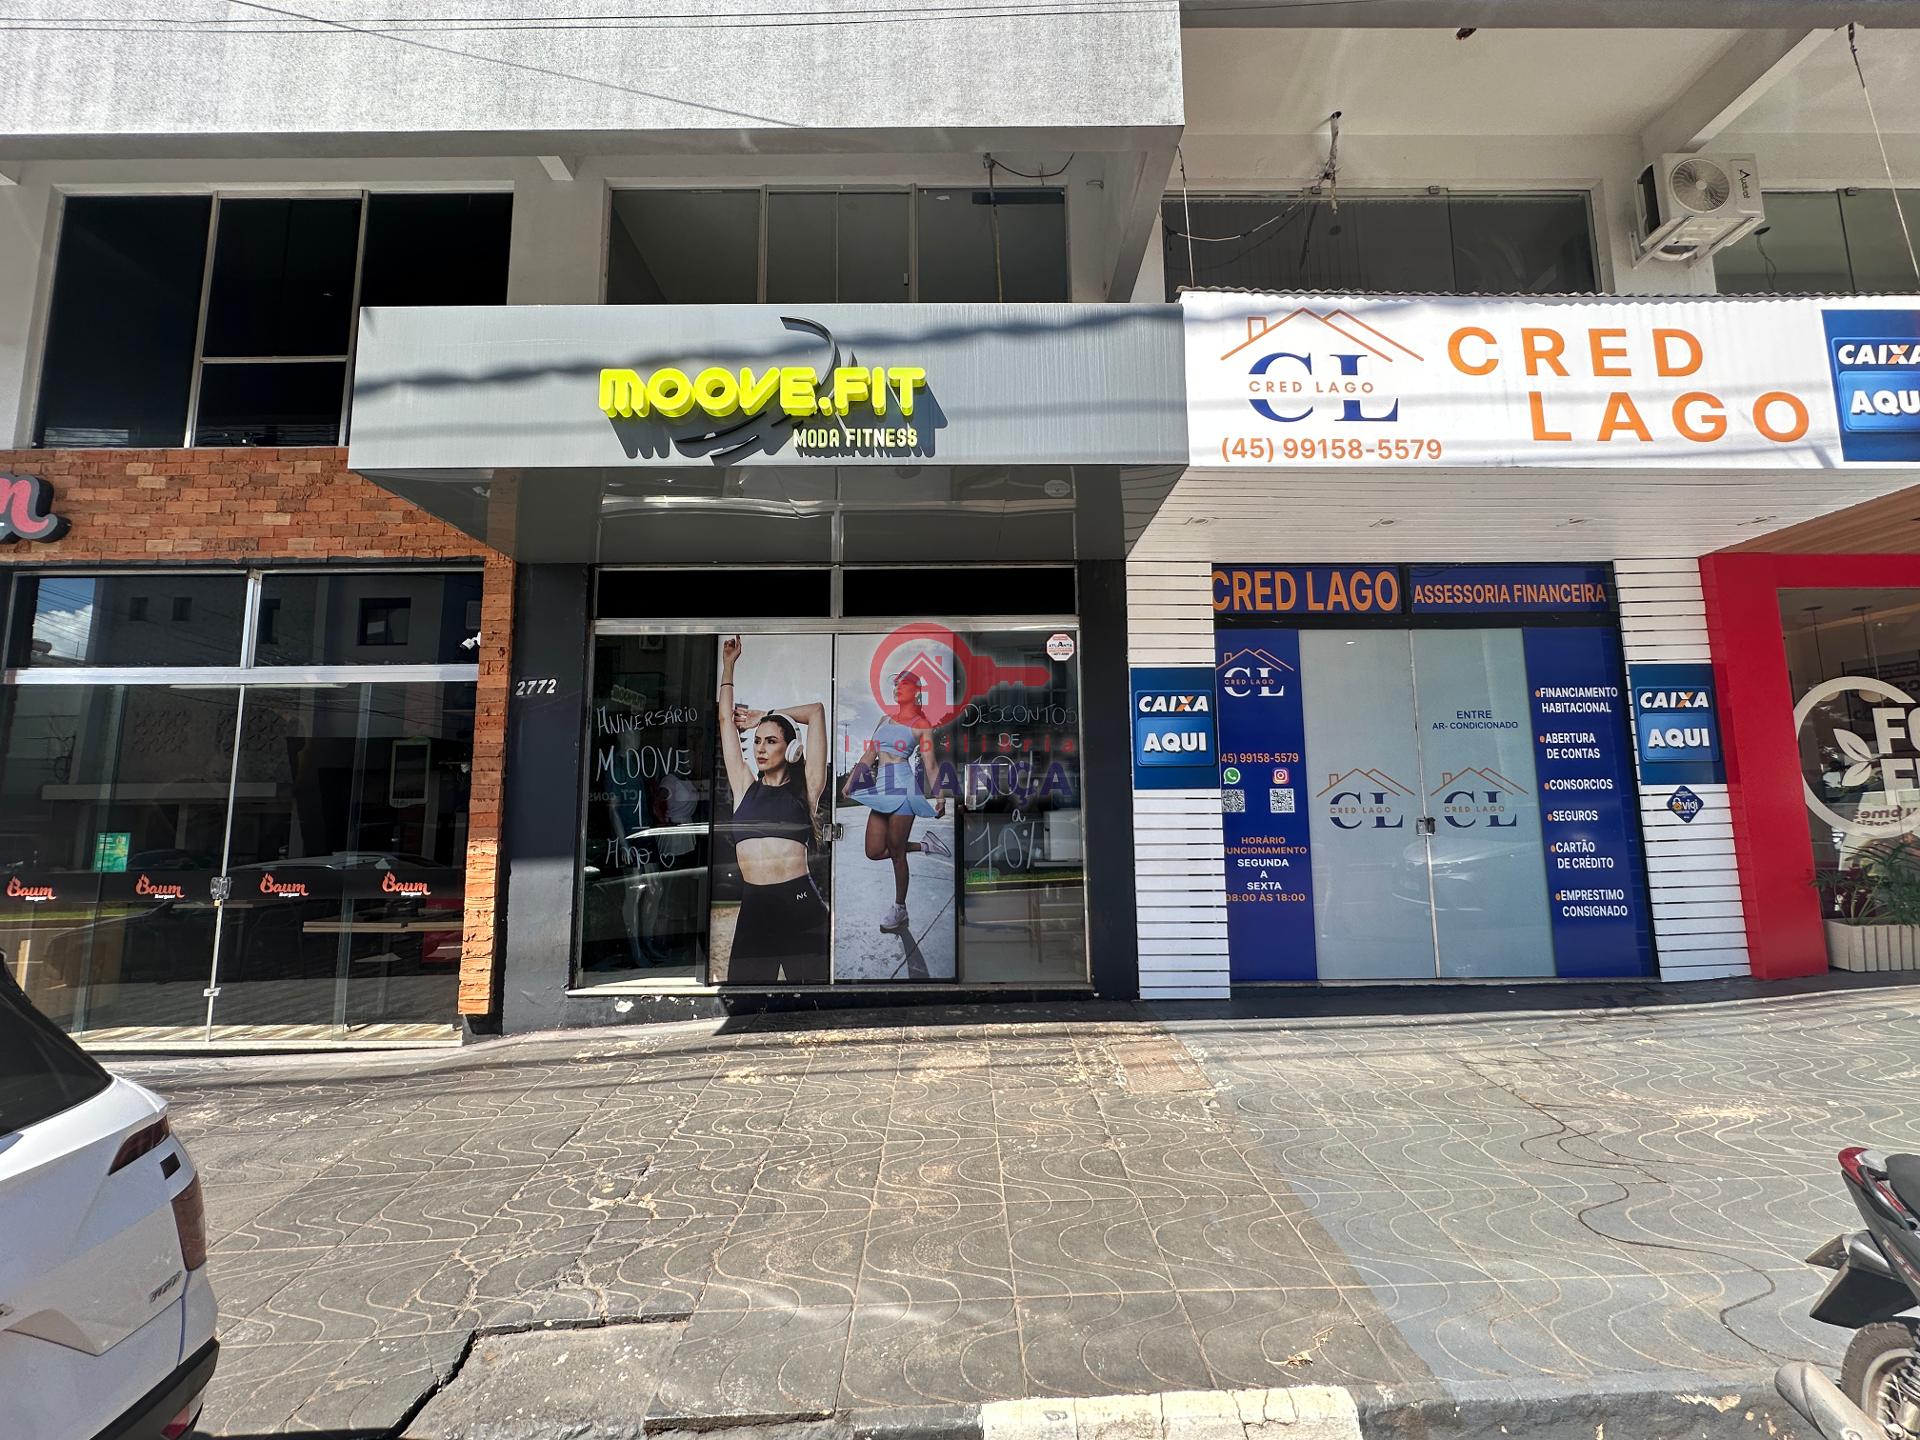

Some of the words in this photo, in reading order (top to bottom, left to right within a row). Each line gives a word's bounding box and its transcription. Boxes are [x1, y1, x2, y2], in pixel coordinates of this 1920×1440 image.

[1448, 326, 1703, 377] CRED
[598, 366, 926, 418] MOOVE.FIT
[1249, 380, 1303, 393] CRED
[1315, 381, 1374, 393] LAGO
[1528, 391, 1809, 443] LAGO
[793, 428, 840, 448] MODA
[844, 427, 918, 448] FITNESS
[1221, 437, 1274, 463] (45)
[1283, 438, 1442, 460] 99158-5579
[1213, 570, 1297, 612] CRED
[1305, 570, 1399, 612] LAGO
[1413, 583, 1510, 604] ASSESSORIA
[1513, 582, 1607, 603] FINANCEIRA
[515, 678, 557, 696] 2772
[1540, 687, 1618, 698] FINANCIAMENTO
[1138, 695, 1209, 712] CAIXA
[1638, 691, 1709, 709] CAIXA
[1541, 702, 1612, 713] HABITACIONAL
[1456, 710, 1492, 719] ENTRE
[1432, 722, 1448, 730] AR-
[1449, 721, 1518, 730] CONDICIONADO
[998, 733, 1022, 747] DE
[1143, 731, 1207, 752] AQUI
[1545, 733, 1596, 743] ABERTURA
[1647, 728, 1710, 748] AQUI
[1221, 753, 1237, 764] 45)
[1239, 752, 1299, 763] 99158-5579
[1546, 748, 1559, 759] DE
[1561, 748, 1600, 758] CONTAS
[596, 745, 692, 785] MOOVE
[1549, 779, 1613, 790] CONSORCIOS
[632, 790, 650, 830] 1
[1330, 806, 1357, 814] CRED
[1444, 805, 1471, 813] CRED
[1552, 810, 1598, 821] SEGUROS
[1241, 834, 1286, 844] HORÁRIO
[1555, 839, 1595, 852] CARTÃO
[1224, 846, 1307, 855] UNCIONAMENTO
[1237, 858, 1289, 867] SEGUNDA
[1557, 857, 1570, 868] DE
[1572, 854, 1614, 868] CRÉDITO
[1260, 870, 1268, 878] A
[6, 876, 56, 899] Baum
[135, 874, 185, 898] Baum
[259, 873, 309, 896] Baum
[382, 872, 431, 895] Baum
[1246, 882, 1282, 890] SEXTA
[1275, 893, 1306, 901] 18:00
[1560, 889, 1624, 900] EMPRESTIMO
[1562, 906, 1628, 917] CONSIGNADO
